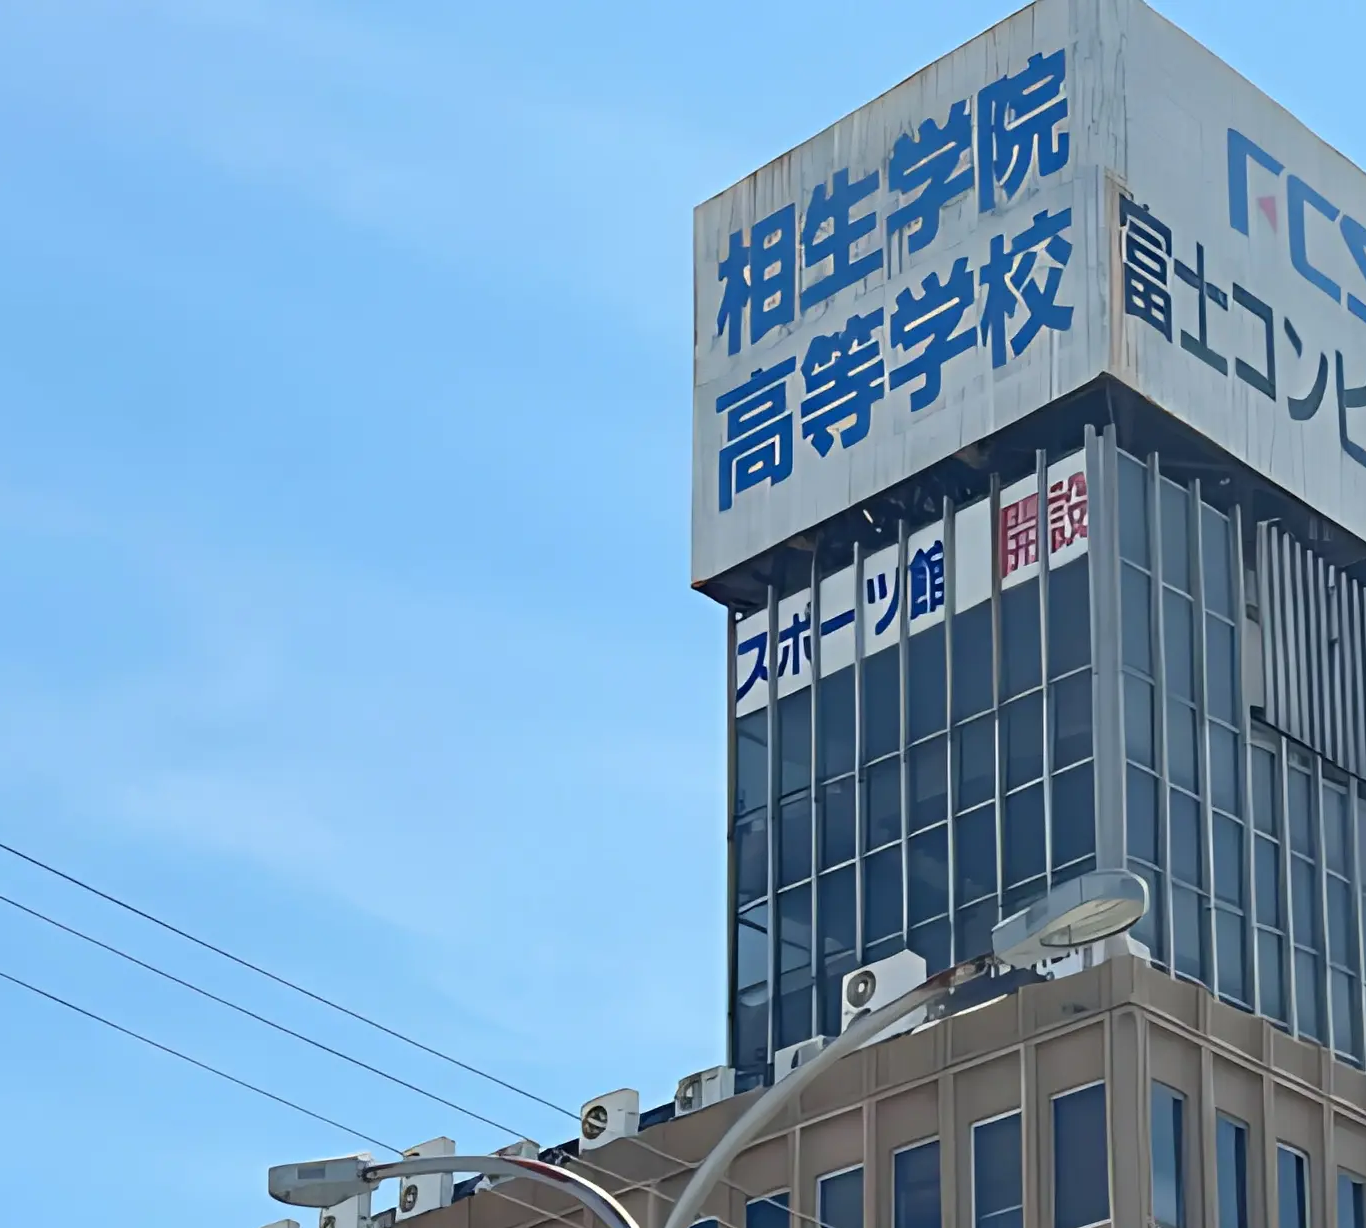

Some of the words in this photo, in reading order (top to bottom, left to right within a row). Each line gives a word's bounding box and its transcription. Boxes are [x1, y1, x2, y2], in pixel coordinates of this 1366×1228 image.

[716, 48, 1071, 356] 相生学院
[716, 208, 1075, 513] 高等学校
